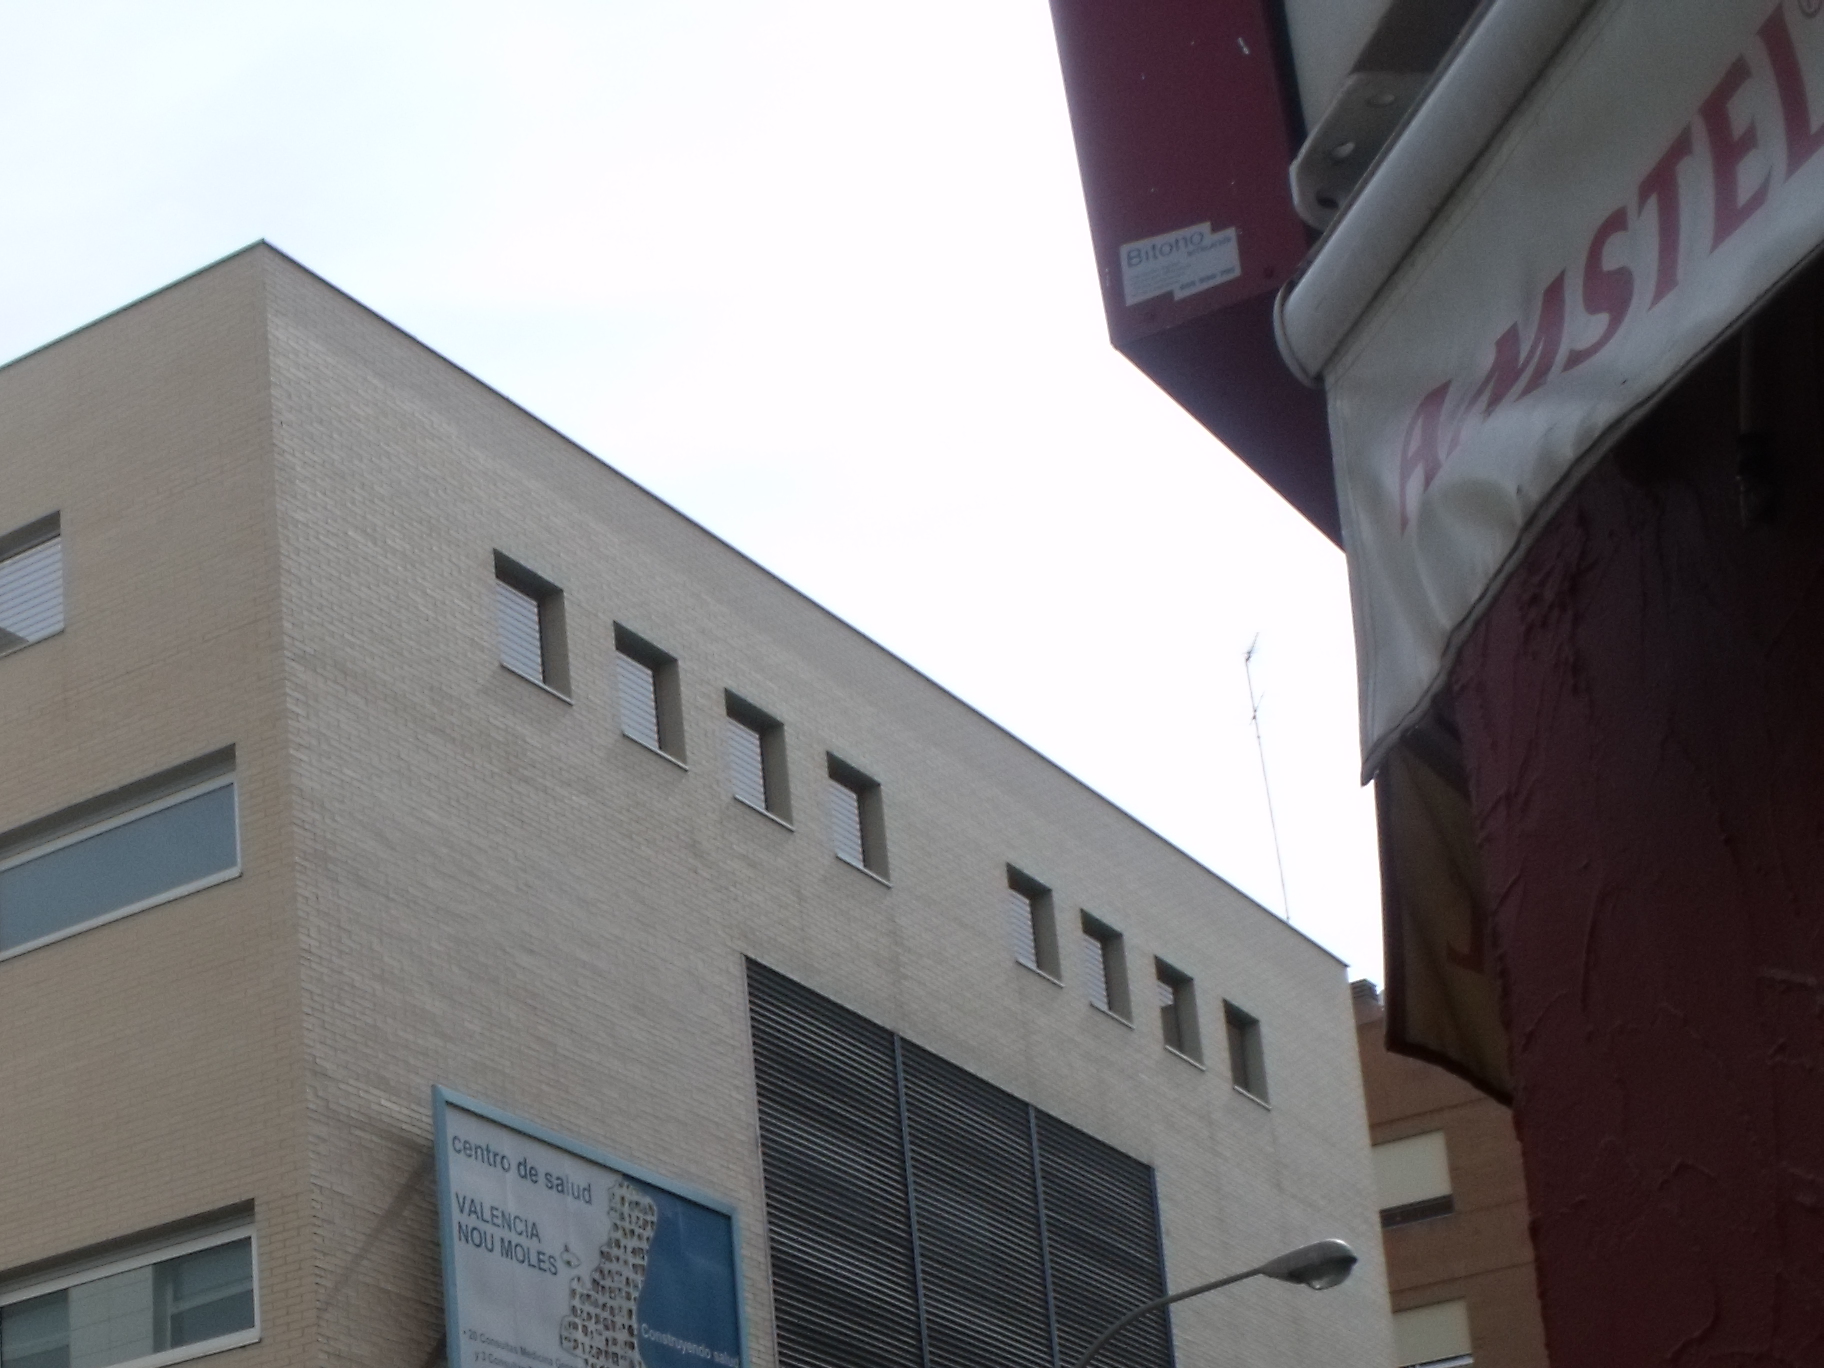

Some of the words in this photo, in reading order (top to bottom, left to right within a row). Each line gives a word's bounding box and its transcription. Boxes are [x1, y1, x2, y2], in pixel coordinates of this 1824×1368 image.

[1399, 2, 1824, 537] AMSTEL
[452, 1135, 511, 1172] centro
[517, 1157, 539, 1184] de
[544, 1172, 593, 1205] salud
[455, 1191, 541, 1244] VALENCIA
[458, 1221, 494, 1253] NOU
[500, 1236, 558, 1276] MOLES
[641, 1323, 711, 1359] Construyendo
[713, 1351, 739, 1368] salud
